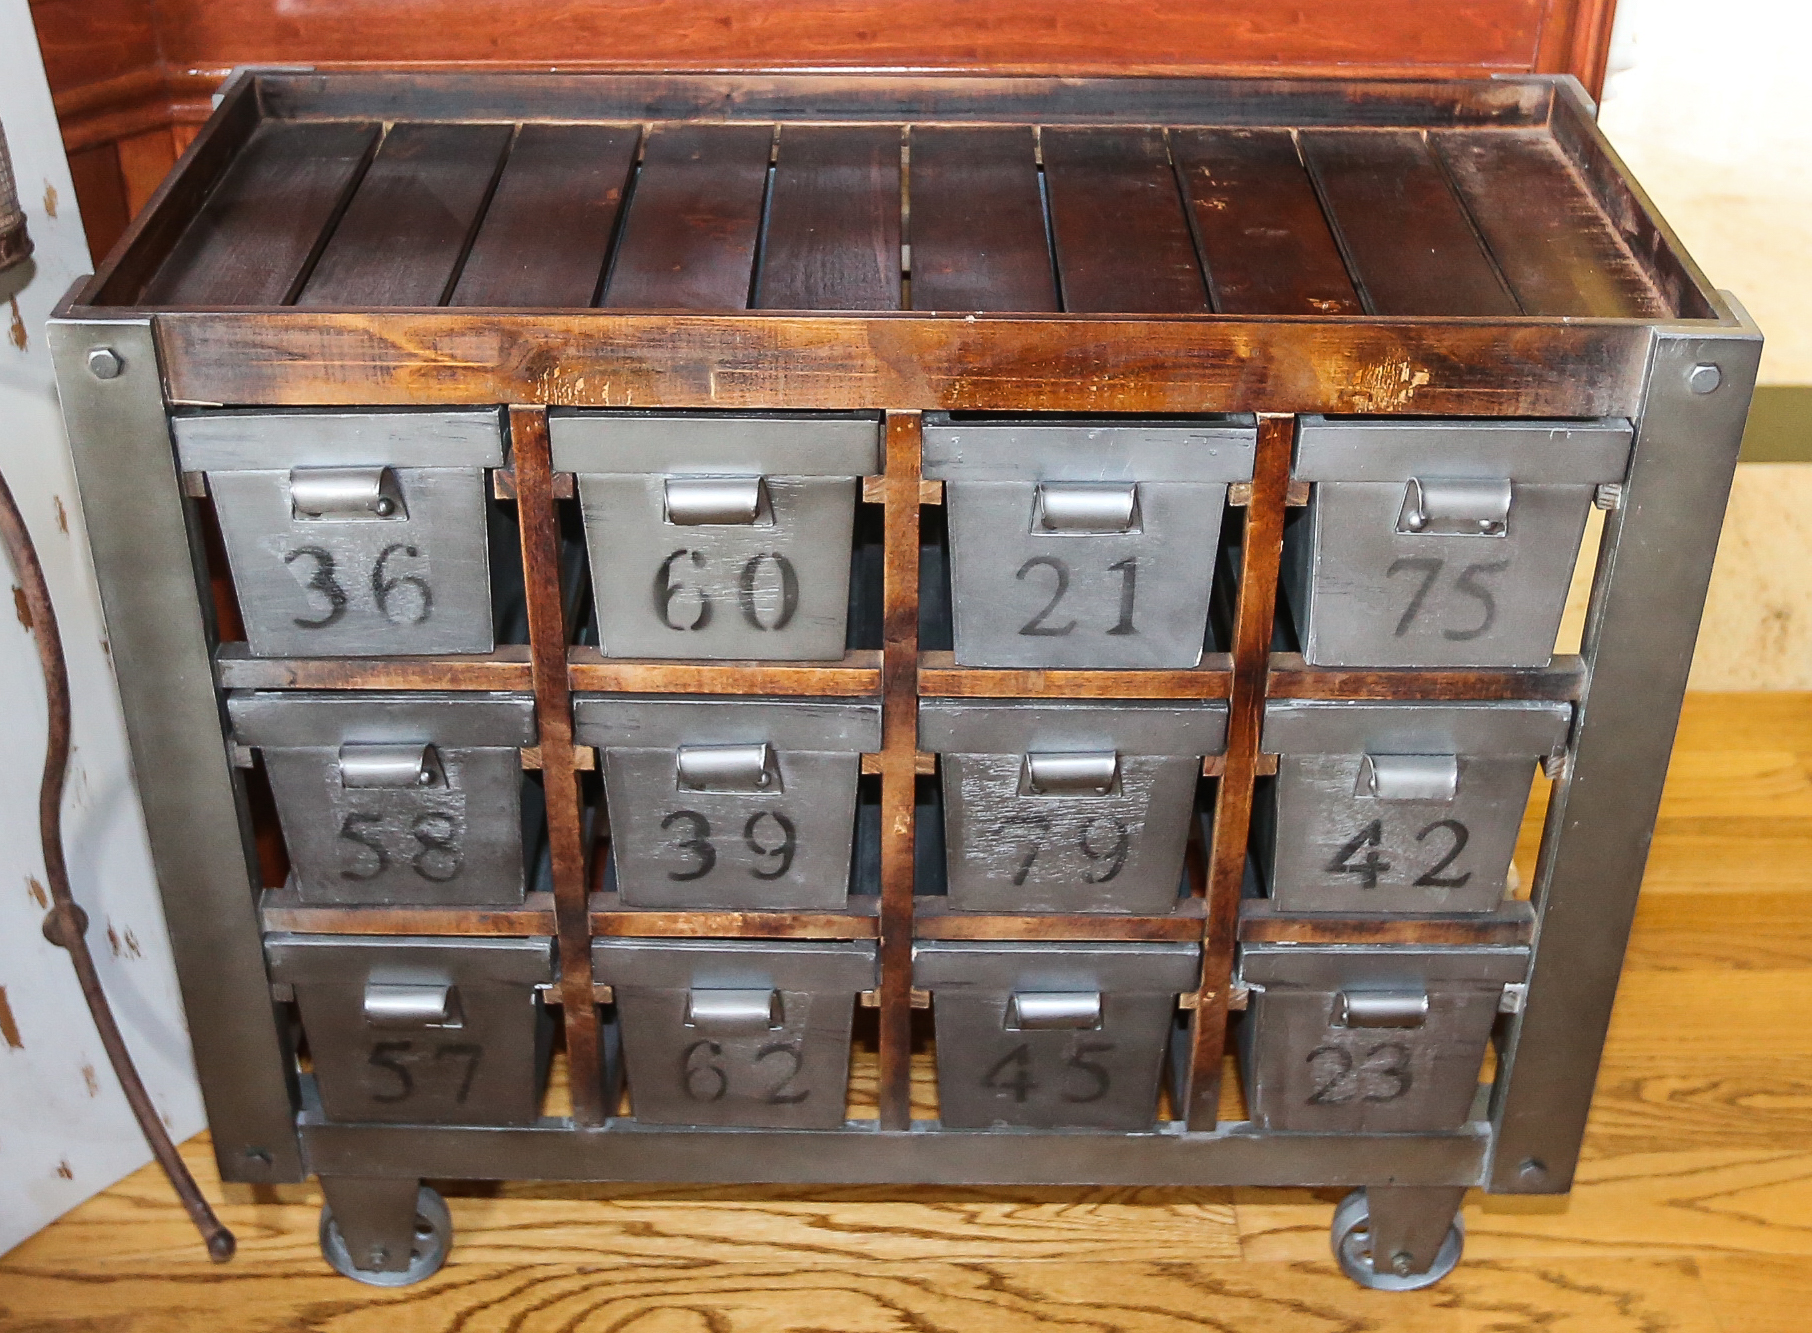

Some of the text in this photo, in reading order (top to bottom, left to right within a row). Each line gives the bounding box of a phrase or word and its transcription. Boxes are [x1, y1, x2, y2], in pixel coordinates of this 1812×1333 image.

[283, 544, 432, 630] 36
[653, 547, 801, 632] 60
[1015, 555, 1141, 637] 21
[1386, 556, 1509, 641] 75
[339, 811, 465, 882] 58
[661, 810, 798, 881] 39
[998, 815, 1129, 885] 79
[1327, 817, 1473, 890] 42
[368, 1041, 483, 1104] 57
[683, 1040, 812, 1106] 62
[981, 1041, 1113, 1105] 45
[1305, 1043, 1414, 1106] 23
